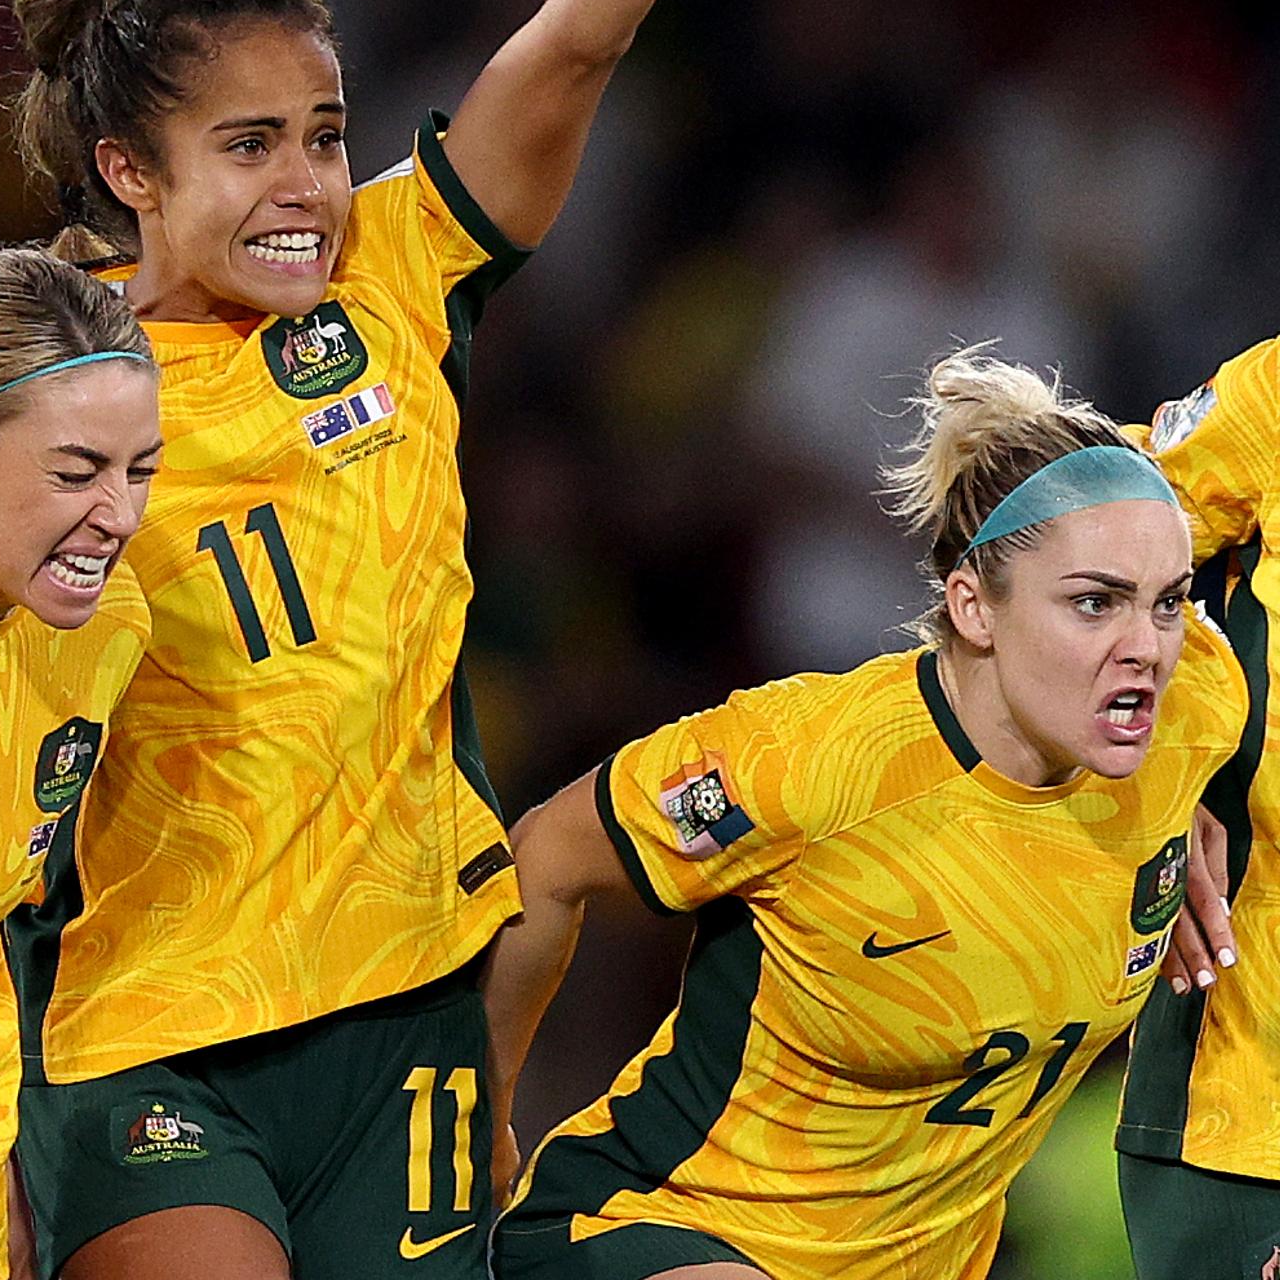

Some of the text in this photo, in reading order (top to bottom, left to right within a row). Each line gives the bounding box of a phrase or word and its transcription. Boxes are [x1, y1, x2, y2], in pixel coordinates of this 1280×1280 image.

[293, 351, 351, 383] AUSTRALIA
[364, 434, 407, 457] AUSTRALIA
[196, 503, 317, 664] 11
[923, 1022, 1090, 1128] 21
[131, 1141, 201, 1155] AUSTRALIA
[401, 1067, 477, 1212] 11
